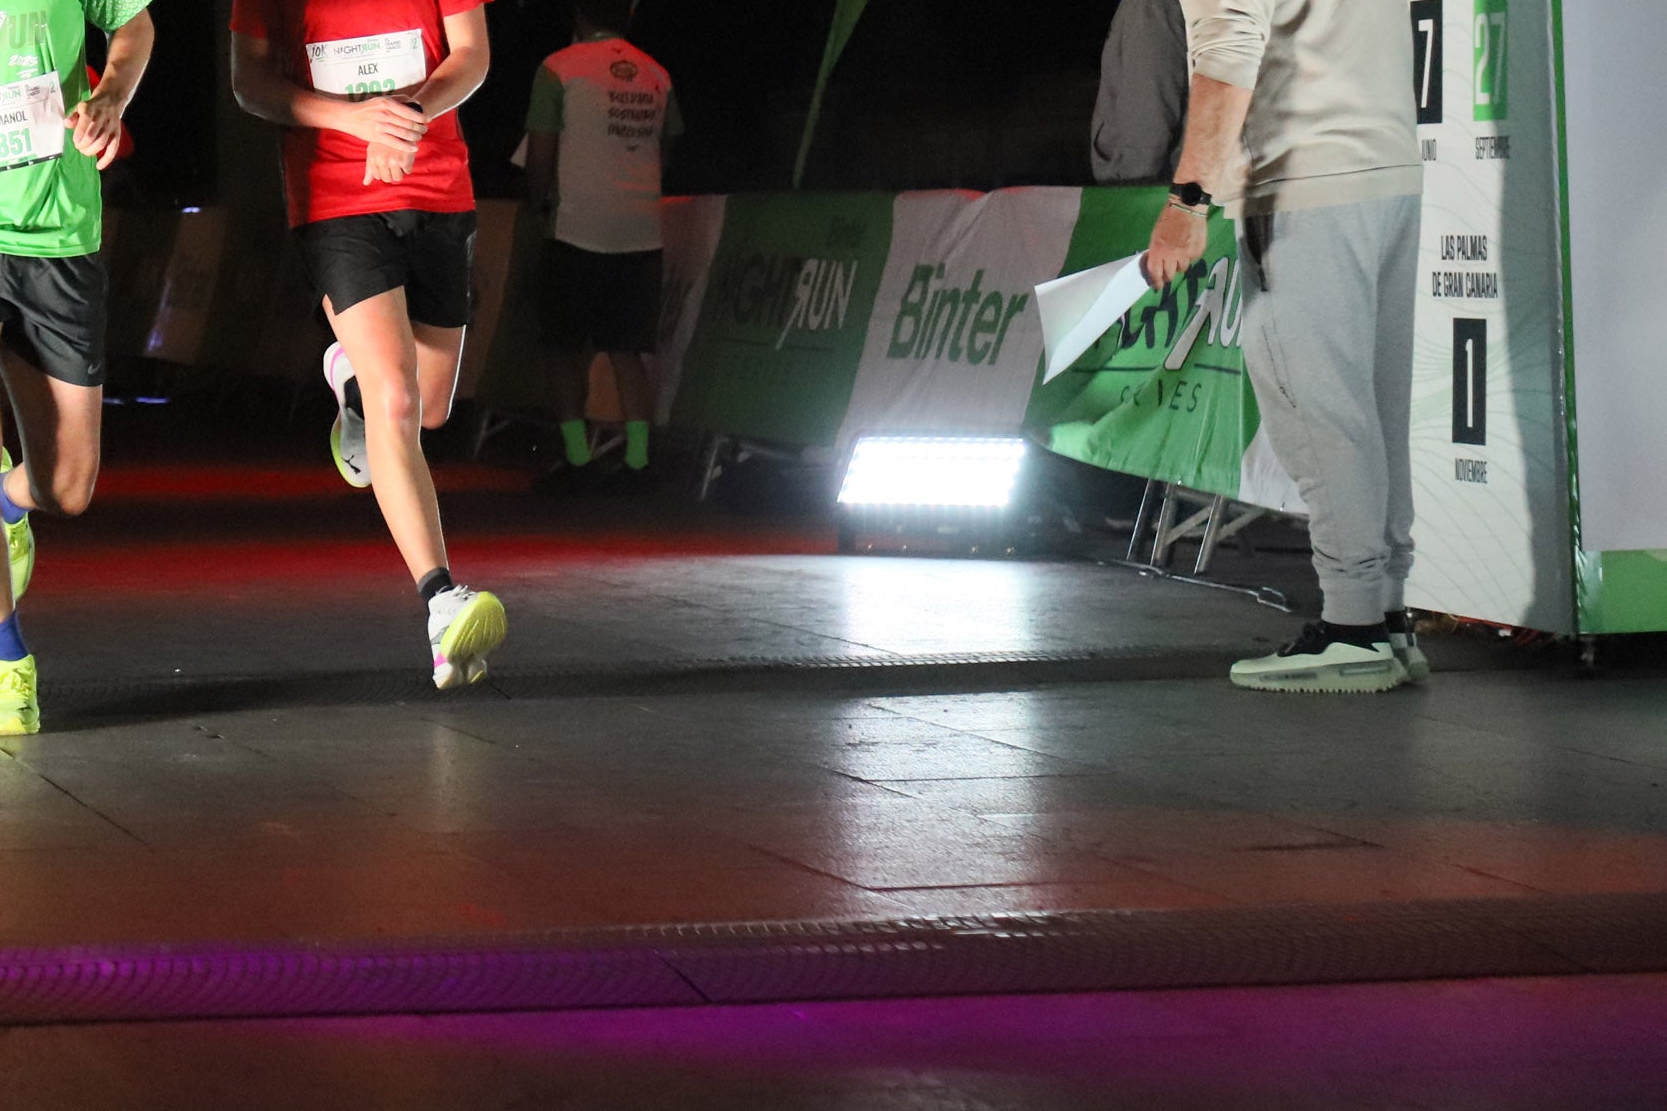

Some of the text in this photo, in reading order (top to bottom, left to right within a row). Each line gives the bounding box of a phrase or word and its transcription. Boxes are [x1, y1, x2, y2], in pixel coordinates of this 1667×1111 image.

[358, 63, 379, 76] ALEX
[1418, 19, 1433, 109] 7
[1474, 11, 1506, 105] 27
[1441, 235, 1488, 262] LAS PALMAS
[1432, 271, 1499, 299] DE GRAN CANARIA
[886, 266, 1028, 366] Binter
[1465, 338, 1474, 428] 1
[1455, 457, 1488, 485] NOVIEMBRE
